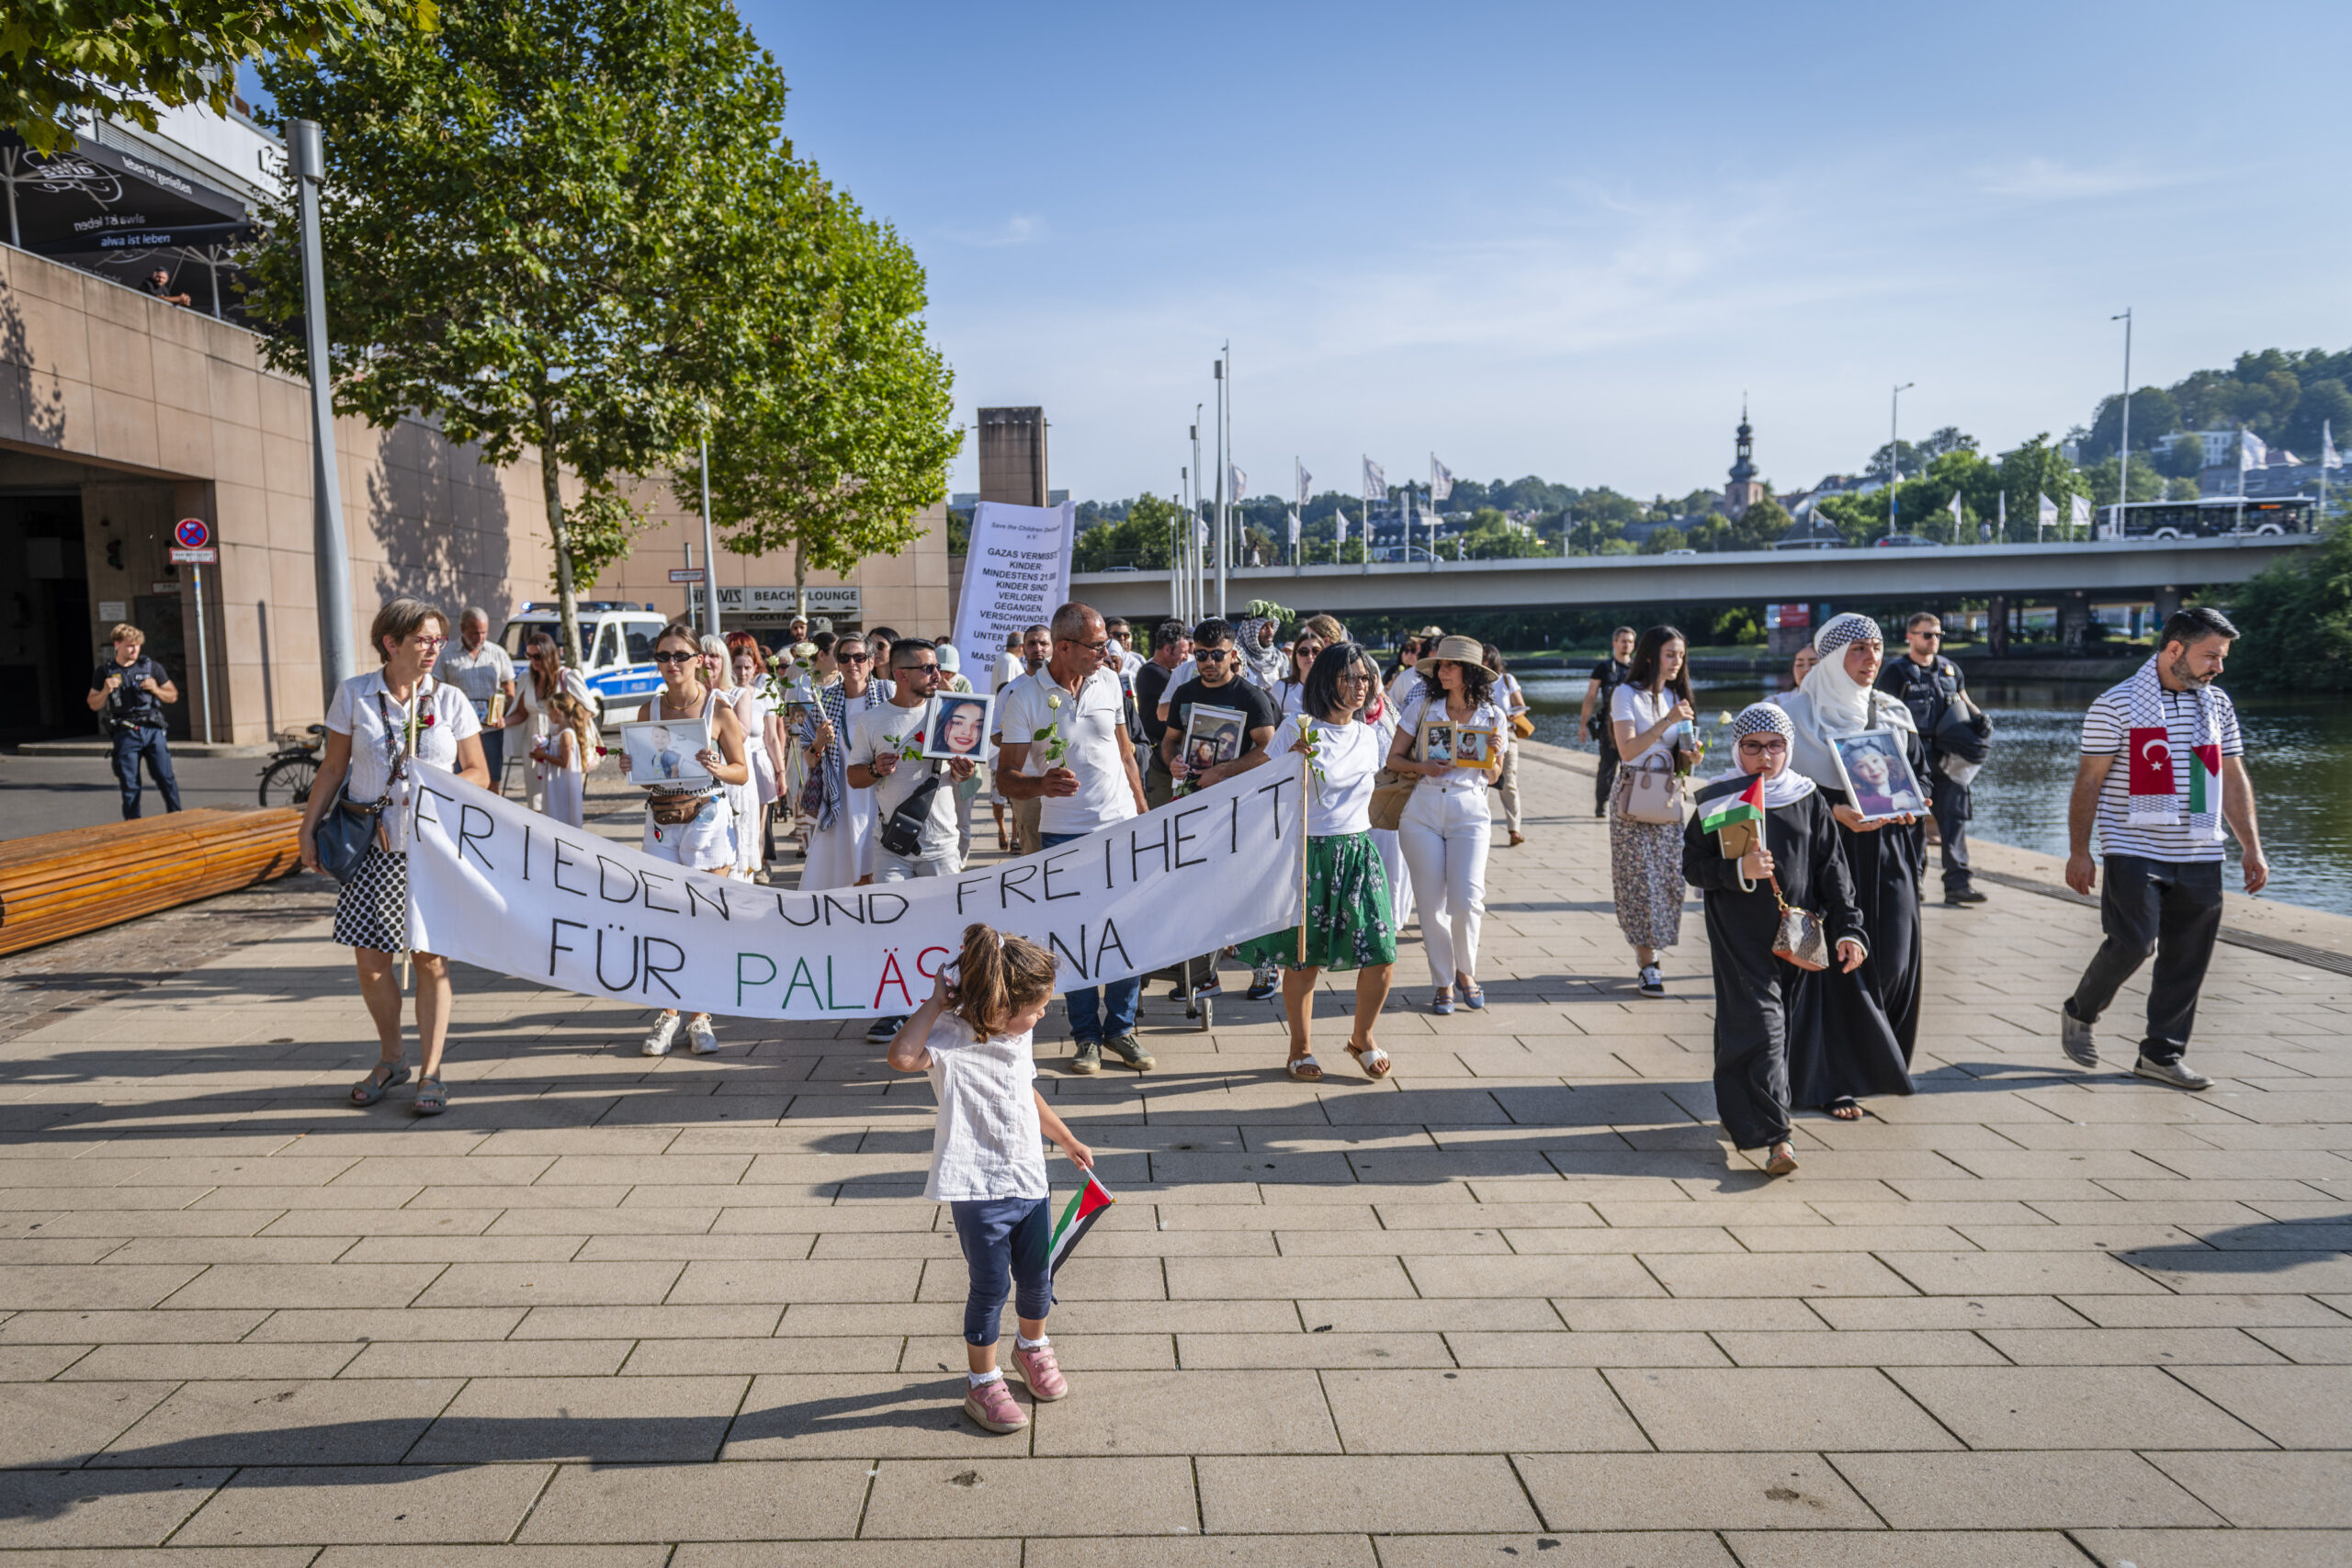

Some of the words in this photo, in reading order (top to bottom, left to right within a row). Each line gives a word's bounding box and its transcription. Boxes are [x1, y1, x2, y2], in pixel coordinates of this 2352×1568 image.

[100, 236, 125, 247] alwa
[128, 235, 141, 244] ist
[142, 233, 171, 244] leben
[988, 547, 1019, 558] GAZAS
[982, 568, 1038, 581] MINDESTENS
[996, 581, 1029, 591] KINDER
[1030, 583, 1049, 592] SIND
[754, 591, 795, 602] BEACH
[808, 591, 857, 602] LOUNGE
[999, 592, 1044, 602] VERLOREN
[974, 630, 1004, 641] UNTER
[414, 785, 730, 921] FRIEDEN
[775, 893, 910, 927] UND
[956, 776, 1295, 916] FREIHEIT
[549, 919, 685, 1000] FÜR
